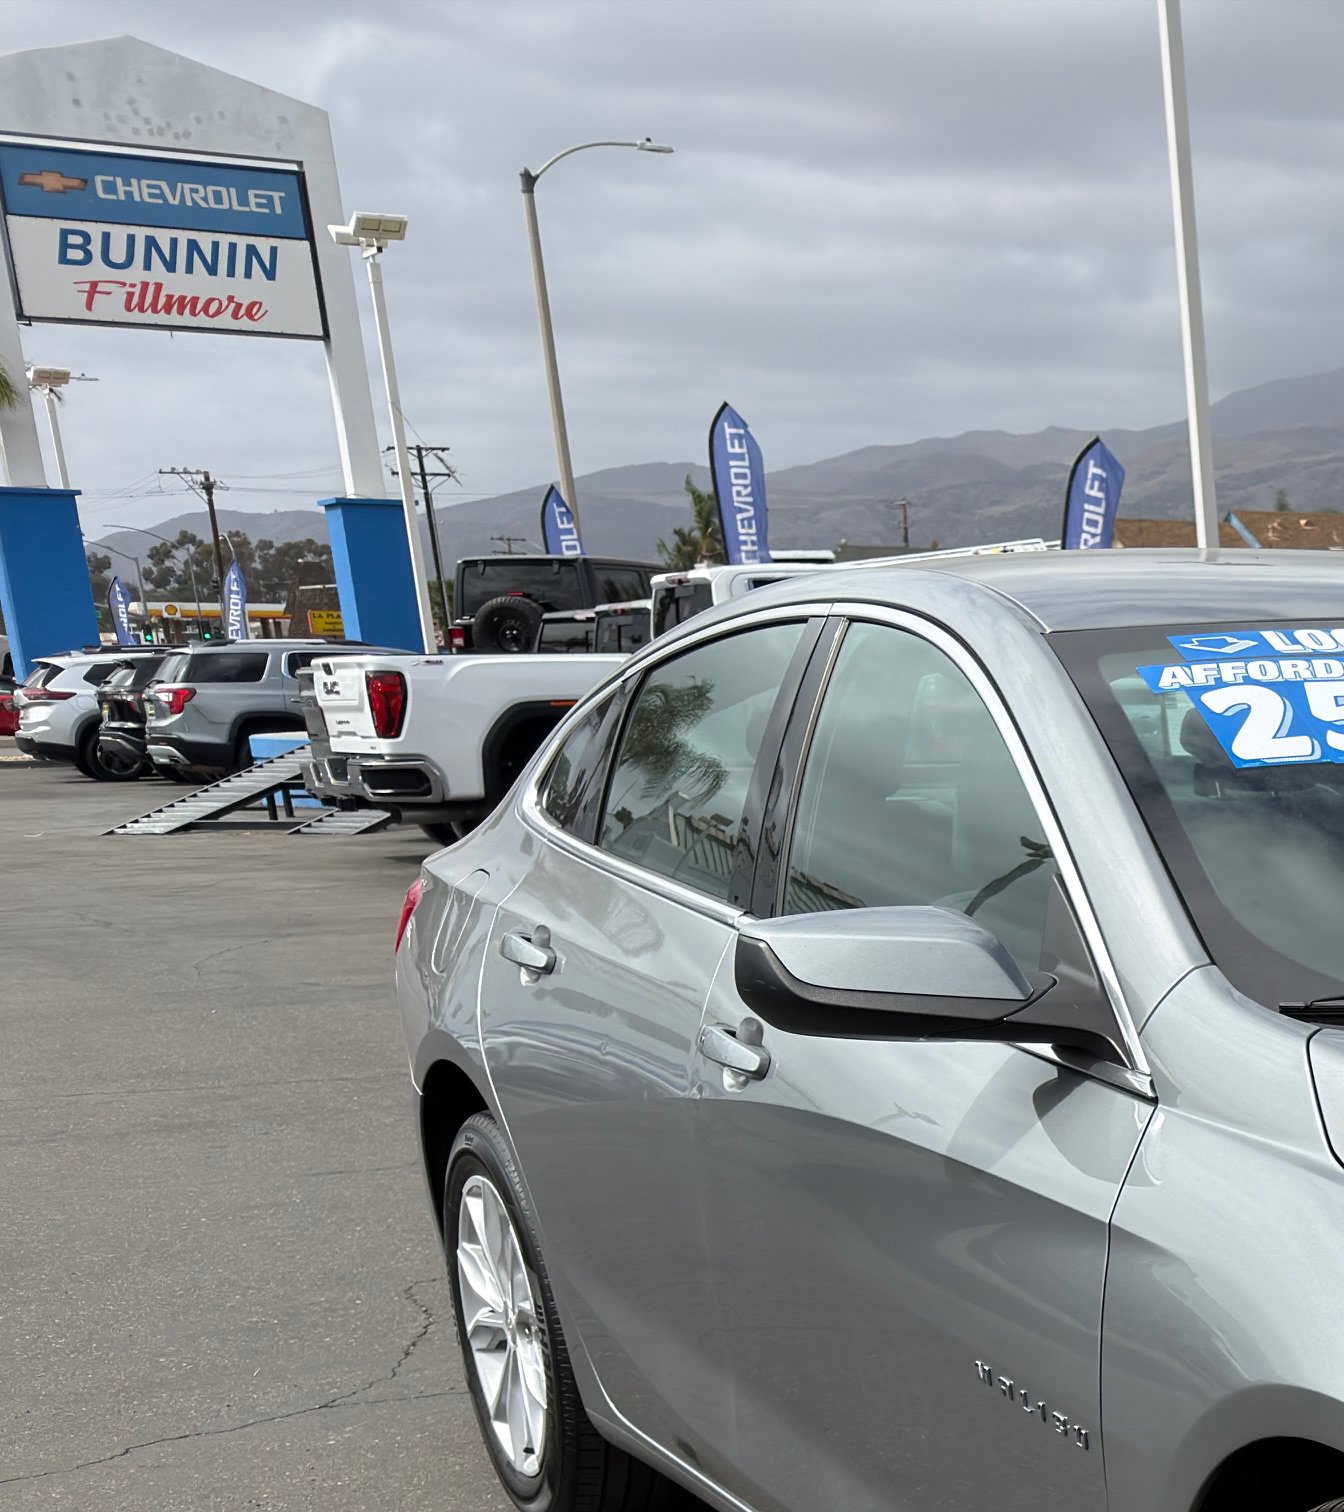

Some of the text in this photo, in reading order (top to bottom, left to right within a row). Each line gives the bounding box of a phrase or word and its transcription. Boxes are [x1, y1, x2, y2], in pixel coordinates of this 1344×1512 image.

[94, 174, 286, 215] CHEVROLET
[57, 227, 279, 282] BUNNIN
[72, 279, 269, 322] Fillmore
[723, 421, 761, 565] CHEVROLET
